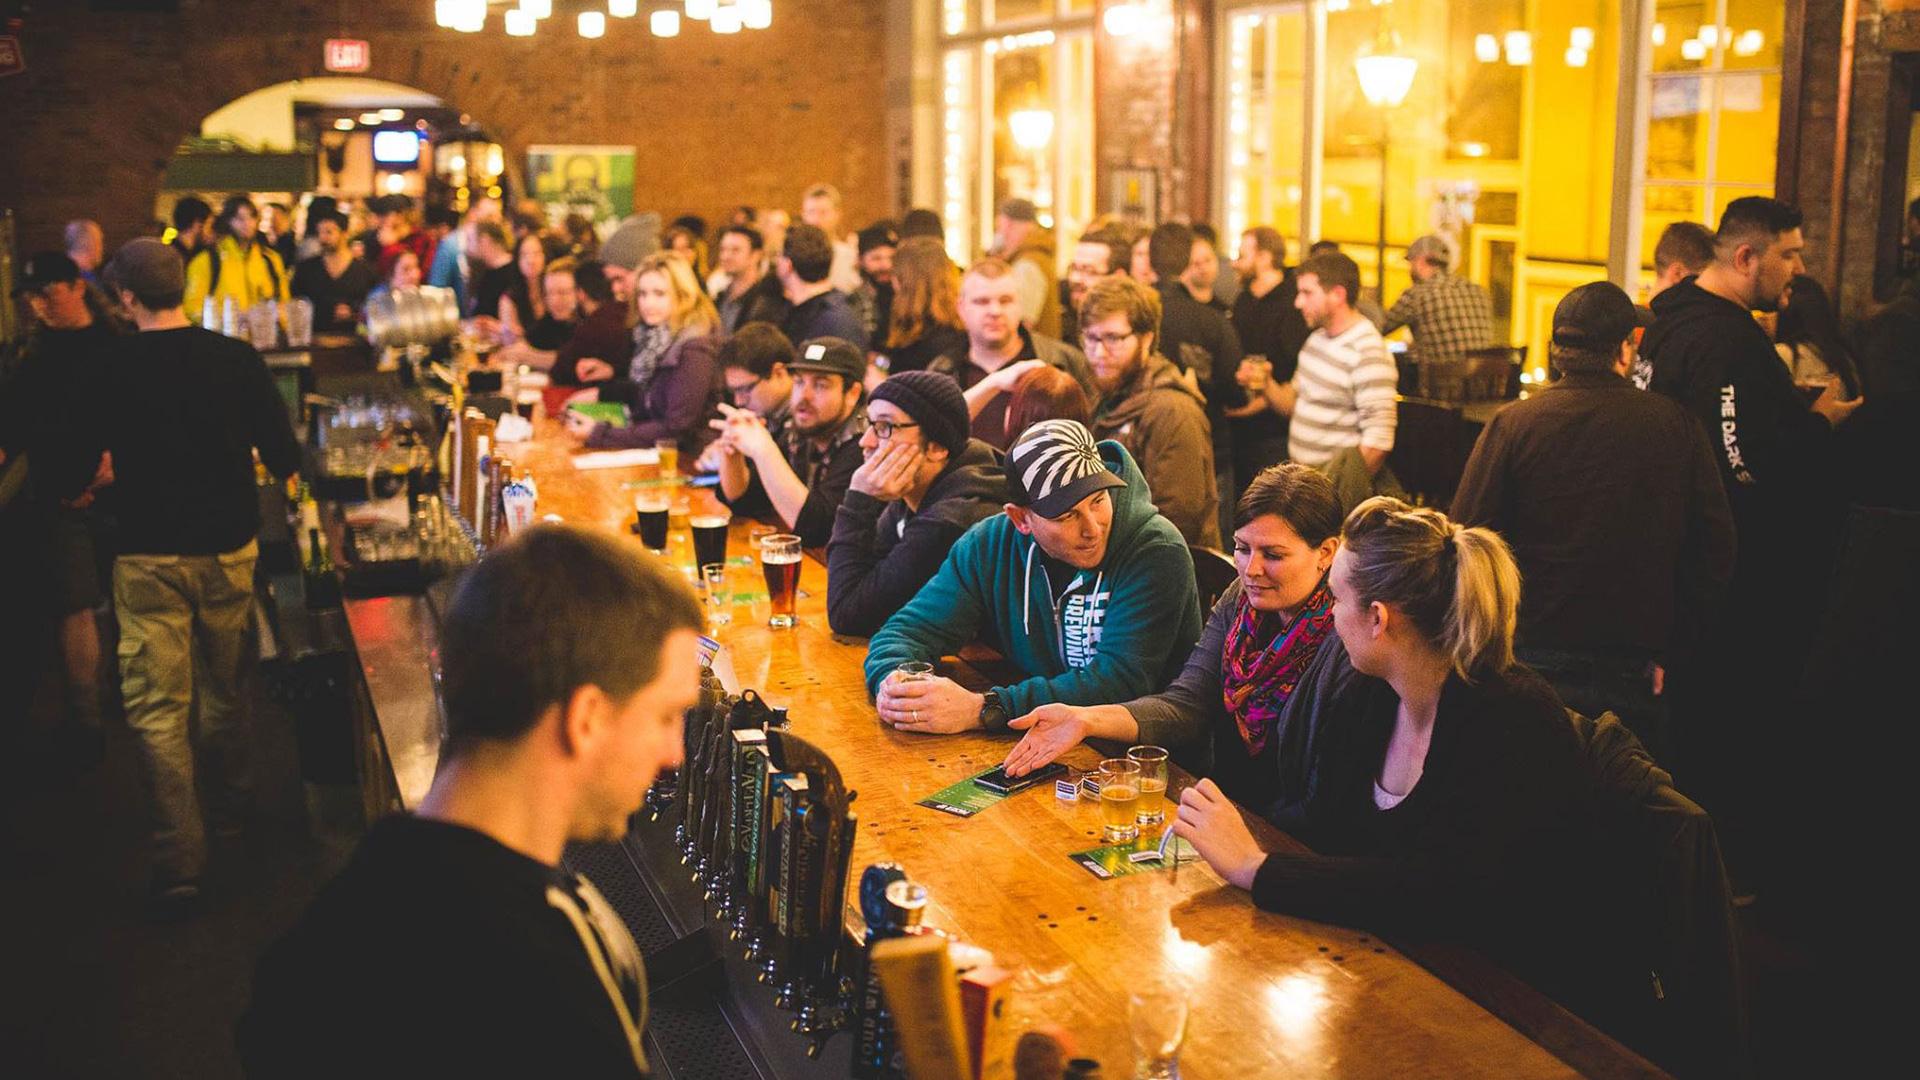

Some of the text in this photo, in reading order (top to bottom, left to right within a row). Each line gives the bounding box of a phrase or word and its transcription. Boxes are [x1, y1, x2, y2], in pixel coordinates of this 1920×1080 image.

[1720, 385, 1736, 418] THE
[1722, 421, 1745, 469] DARK
[1064, 594, 1086, 668] BREWING
